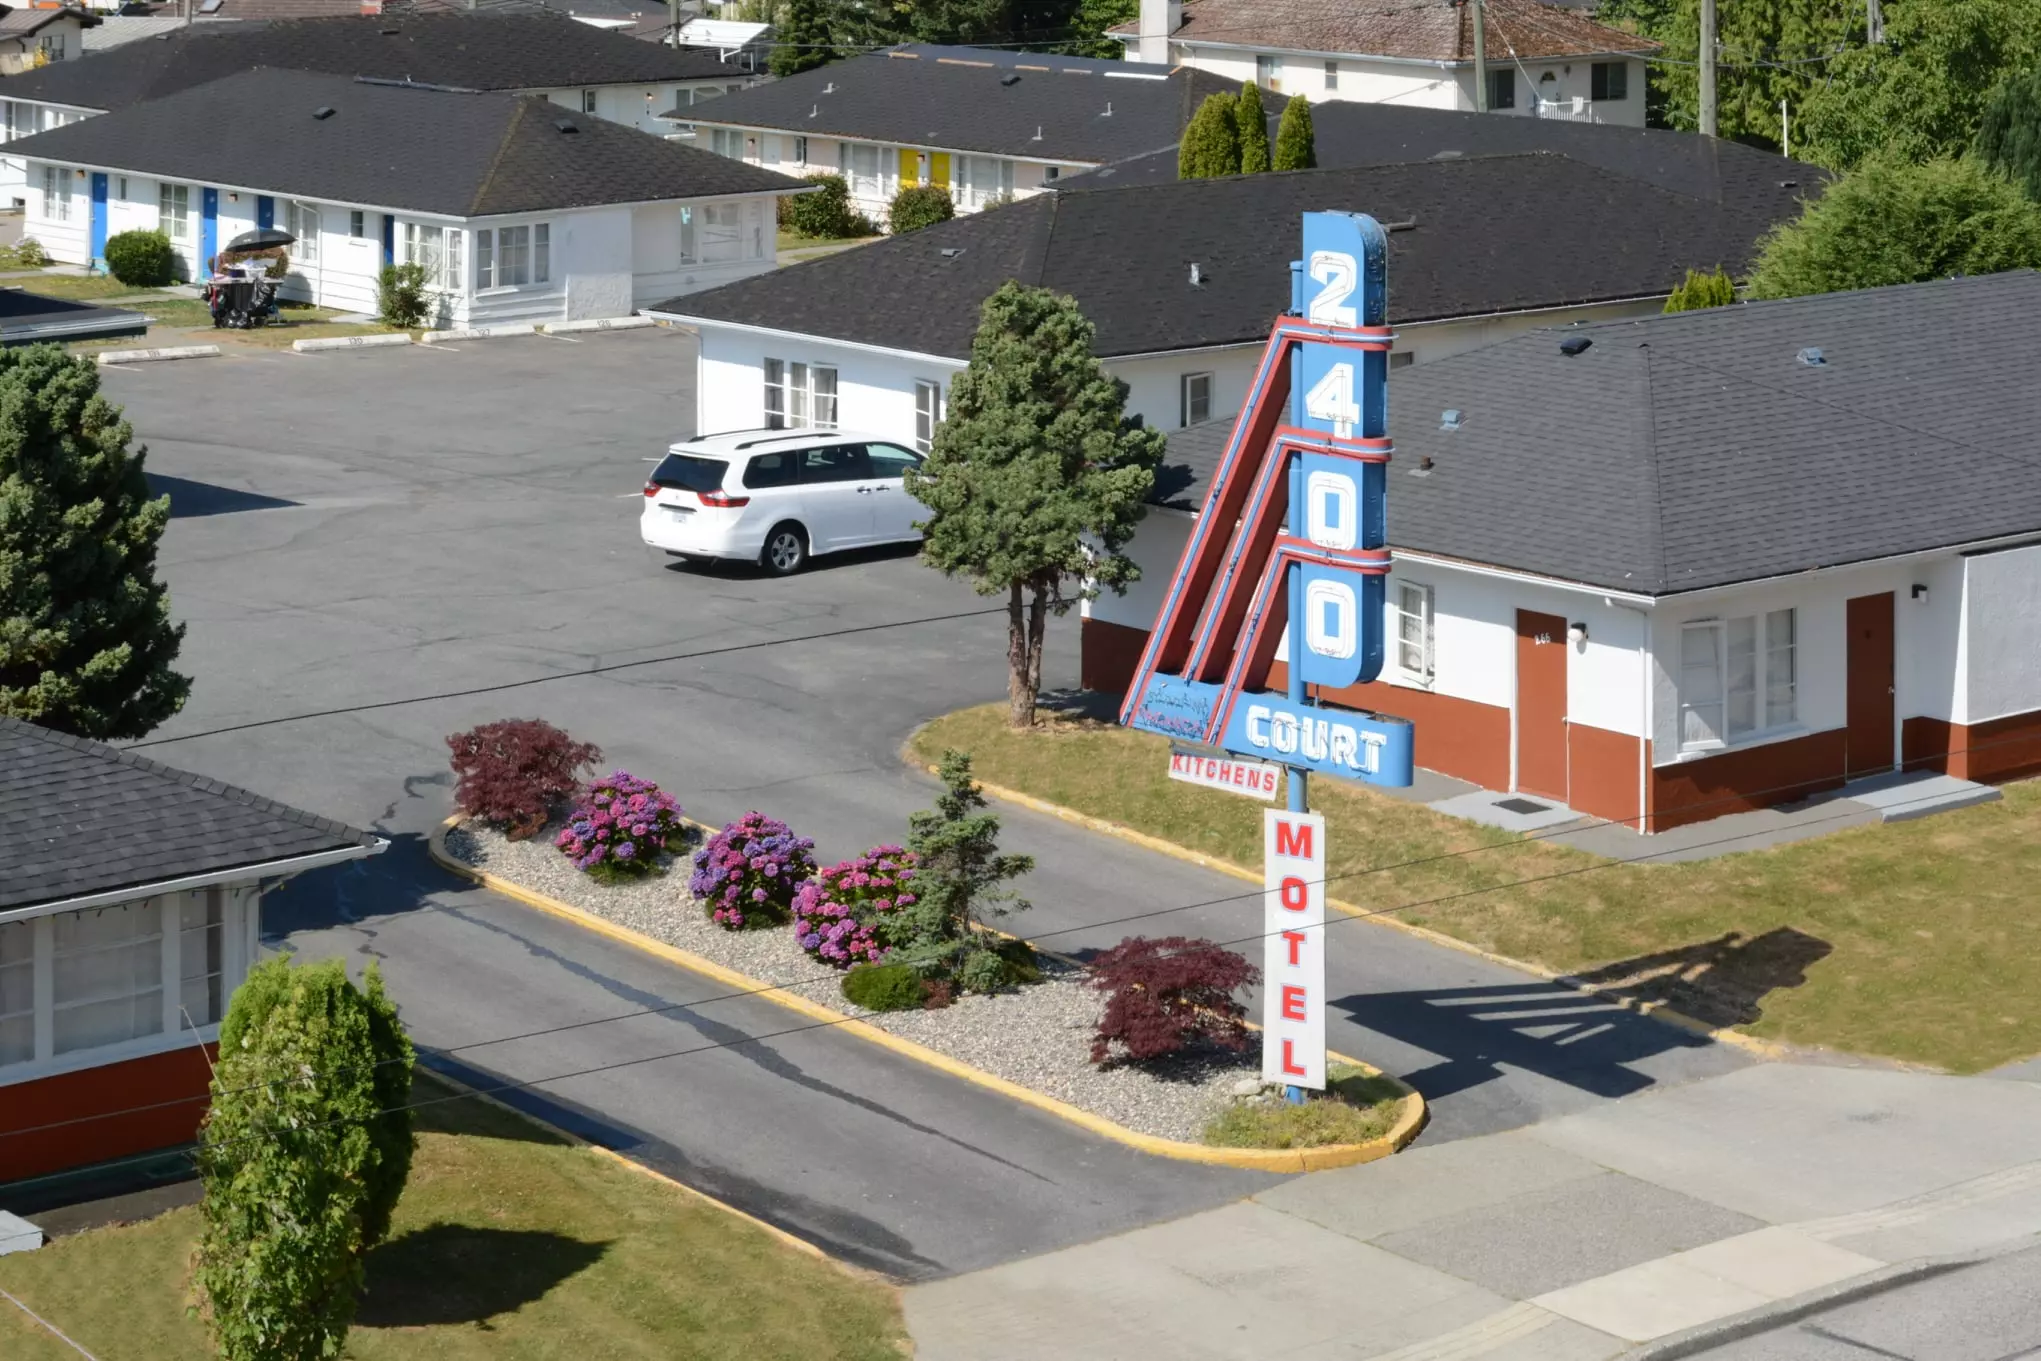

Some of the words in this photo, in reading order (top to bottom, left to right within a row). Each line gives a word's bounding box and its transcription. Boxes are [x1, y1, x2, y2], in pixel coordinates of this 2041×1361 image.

[1305, 249, 1358, 661] 2400
[1172, 754, 1276, 793] KITCHENS
[1246, 704, 1387, 774] COURT
[1275, 818, 1314, 1079] MOTEL
